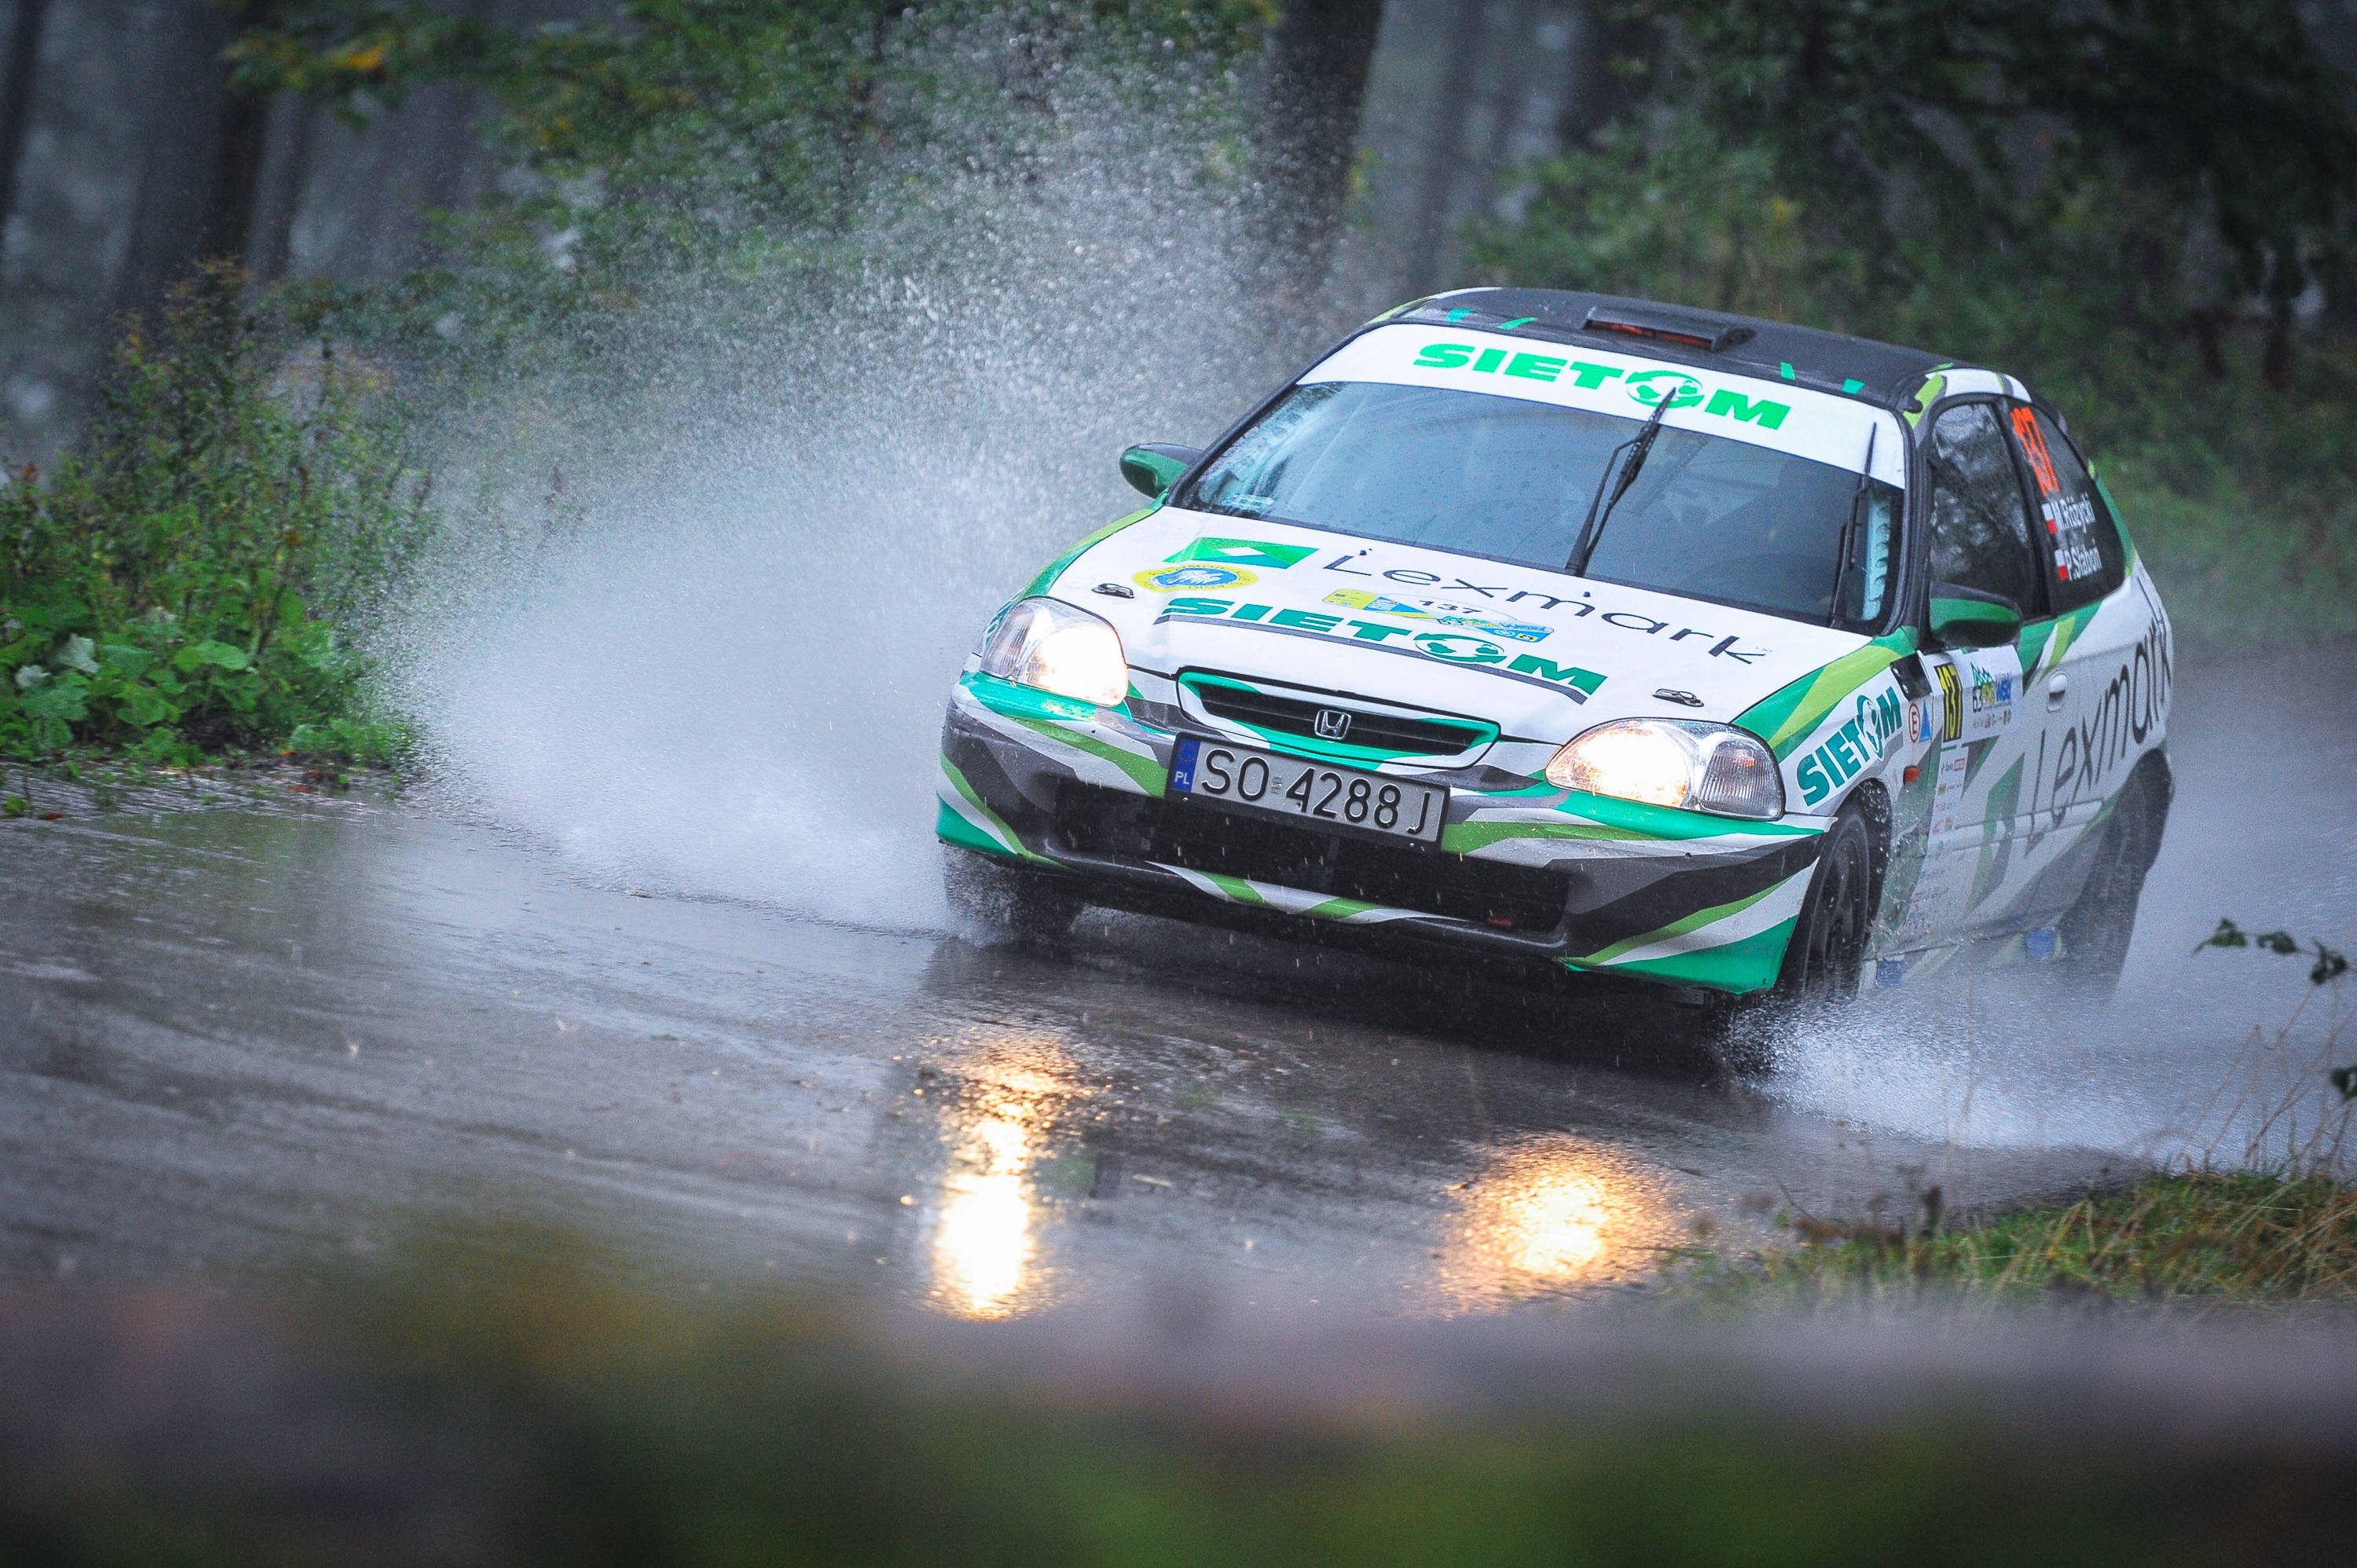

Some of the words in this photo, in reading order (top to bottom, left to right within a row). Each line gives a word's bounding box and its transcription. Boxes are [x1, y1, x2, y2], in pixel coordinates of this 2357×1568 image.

[1413, 343, 1791, 430] SIETOM
[1161, 597, 1607, 696] SIETOM
[1322, 553, 1767, 665] Lexmark
[1417, 600, 1483, 614] 137
[1797, 686, 1903, 807] SIETOM
[1936, 665, 1963, 741] 137
[2024, 606, 2172, 858] Lexmark
[1174, 770, 1189, 786] PL
[1200, 748, 1270, 801] SO
